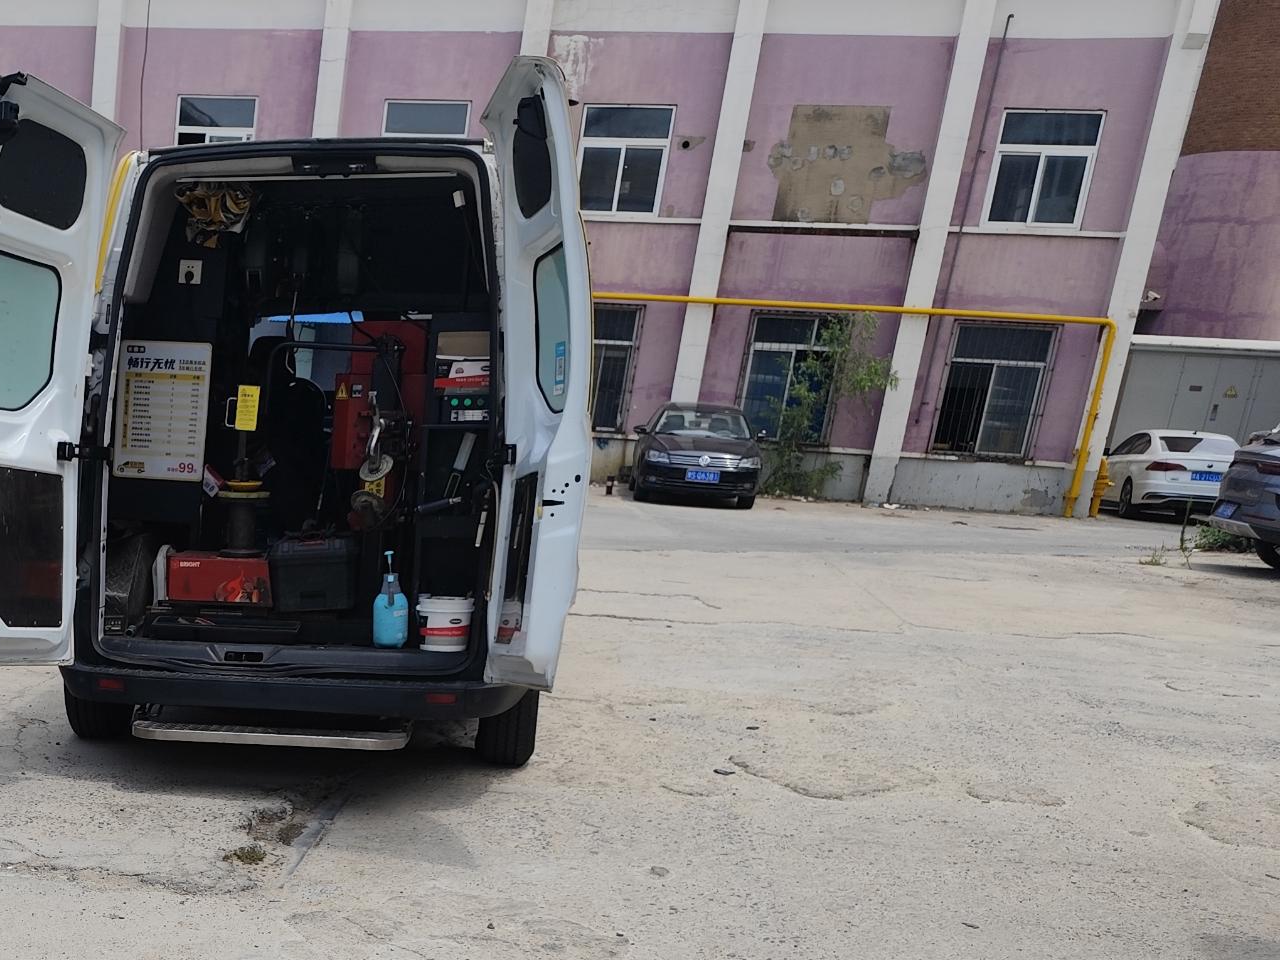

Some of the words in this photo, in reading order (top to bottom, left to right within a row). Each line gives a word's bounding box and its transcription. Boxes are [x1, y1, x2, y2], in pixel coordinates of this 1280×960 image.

[127, 355, 176, 372] 畅行无忧
[179, 462, 194, 474] 99
